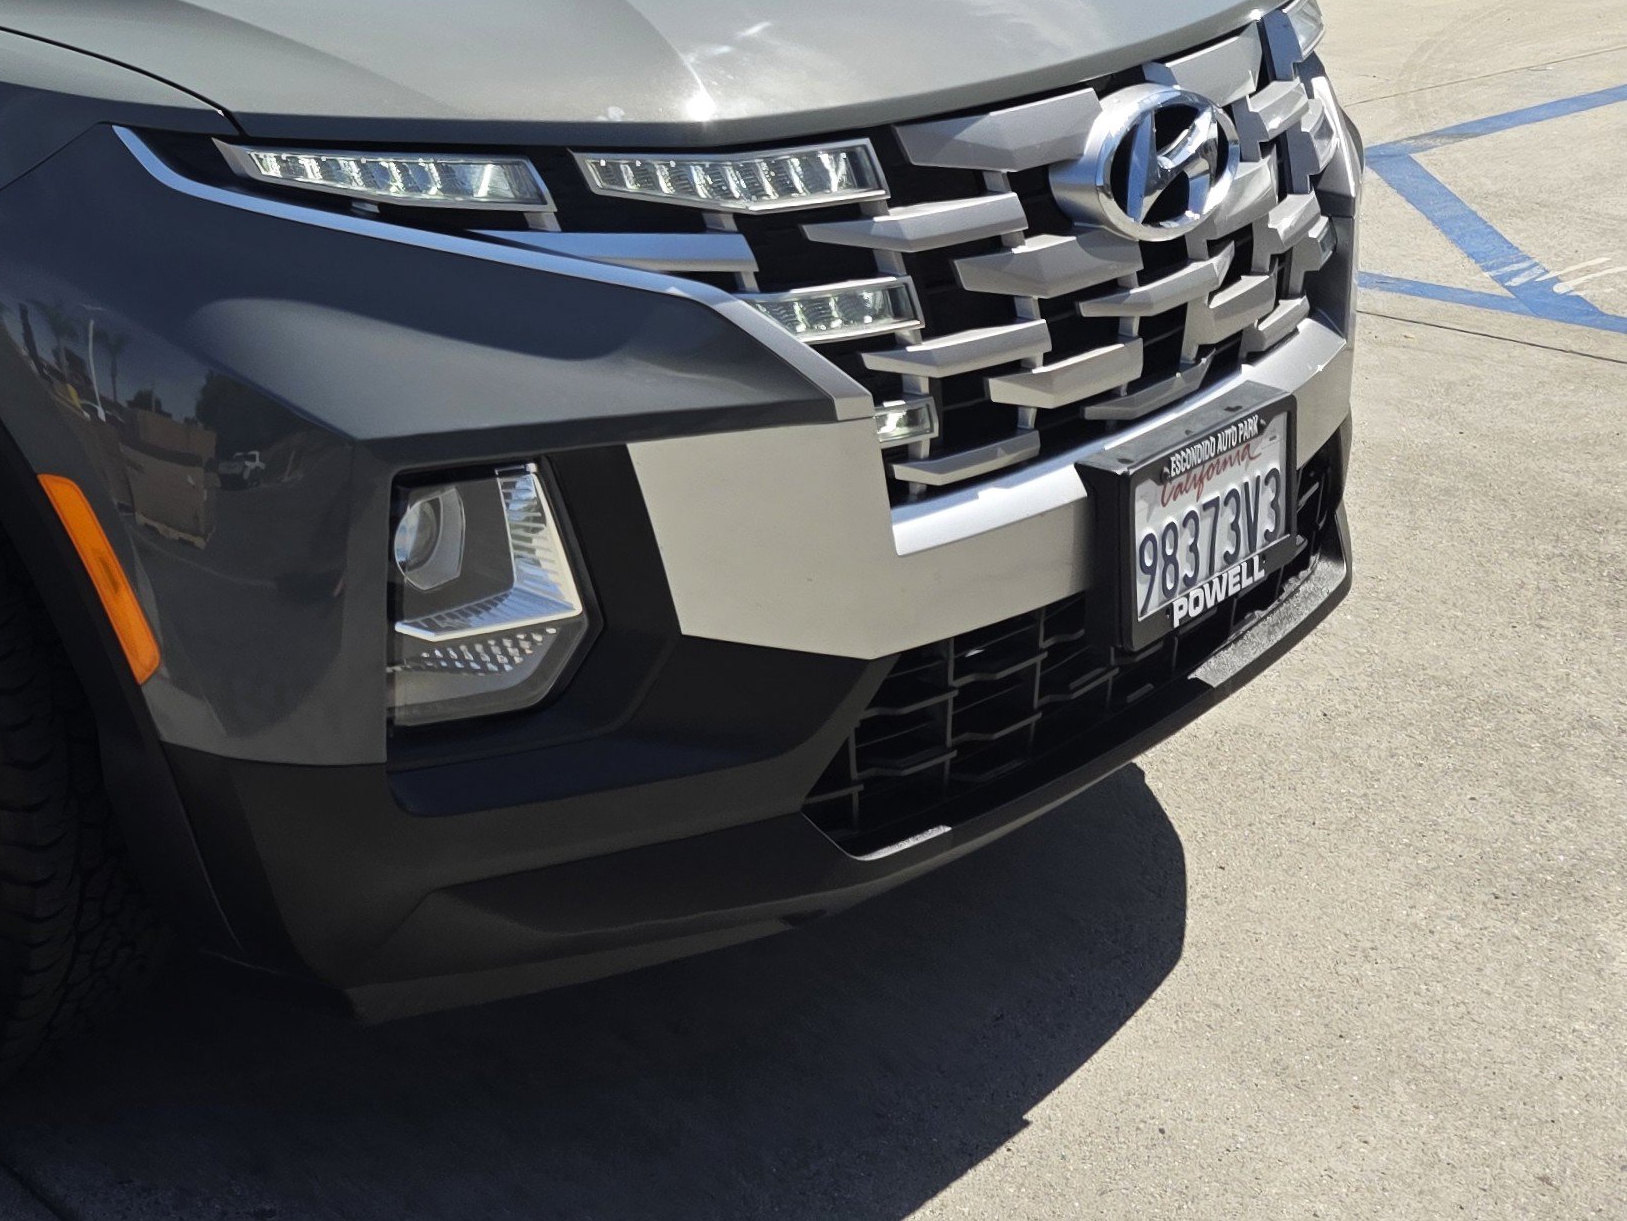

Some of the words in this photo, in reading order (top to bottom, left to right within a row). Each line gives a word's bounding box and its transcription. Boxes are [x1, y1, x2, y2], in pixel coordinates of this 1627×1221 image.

[1161, 443, 1261, 507] California
[1170, 436, 1216, 478] ESCONDIDO
[1217, 425, 1237, 454] AUTO
[1238, 414, 1259, 442] PARK
[1139, 467, 1281, 616] 98373V3
[1173, 555, 1265, 628] POWELL
